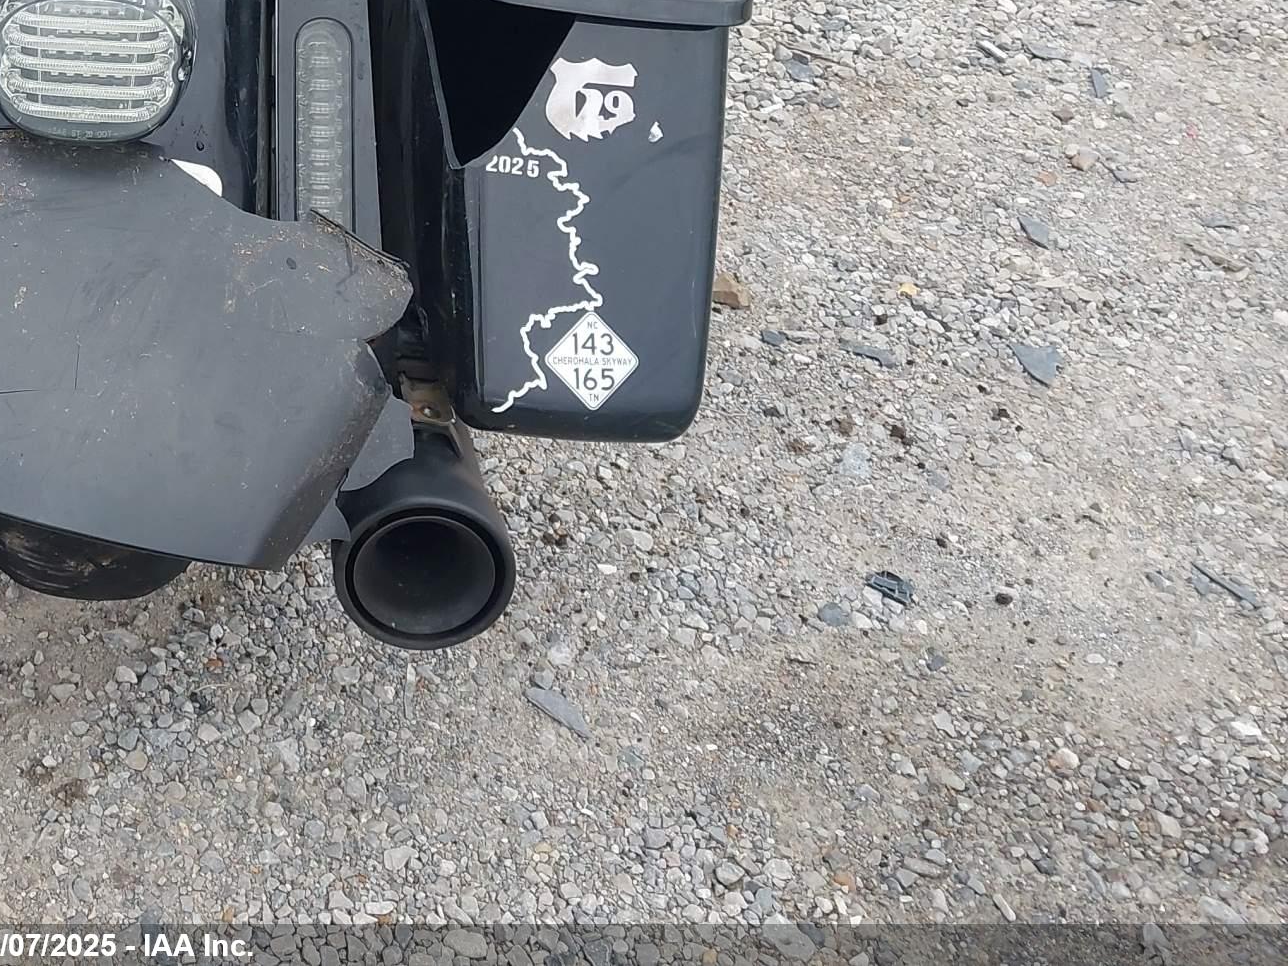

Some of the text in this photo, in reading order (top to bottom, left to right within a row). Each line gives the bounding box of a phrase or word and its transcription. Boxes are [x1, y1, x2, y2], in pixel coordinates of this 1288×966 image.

[486, 155, 540, 178] 2025
[587, 321, 598, 329] NC
[572, 332, 614, 356] 143
[552, 356, 633, 366] CHEROHALA SKYWAY
[573, 367, 615, 391] 165
[588, 393, 600, 402] TN
